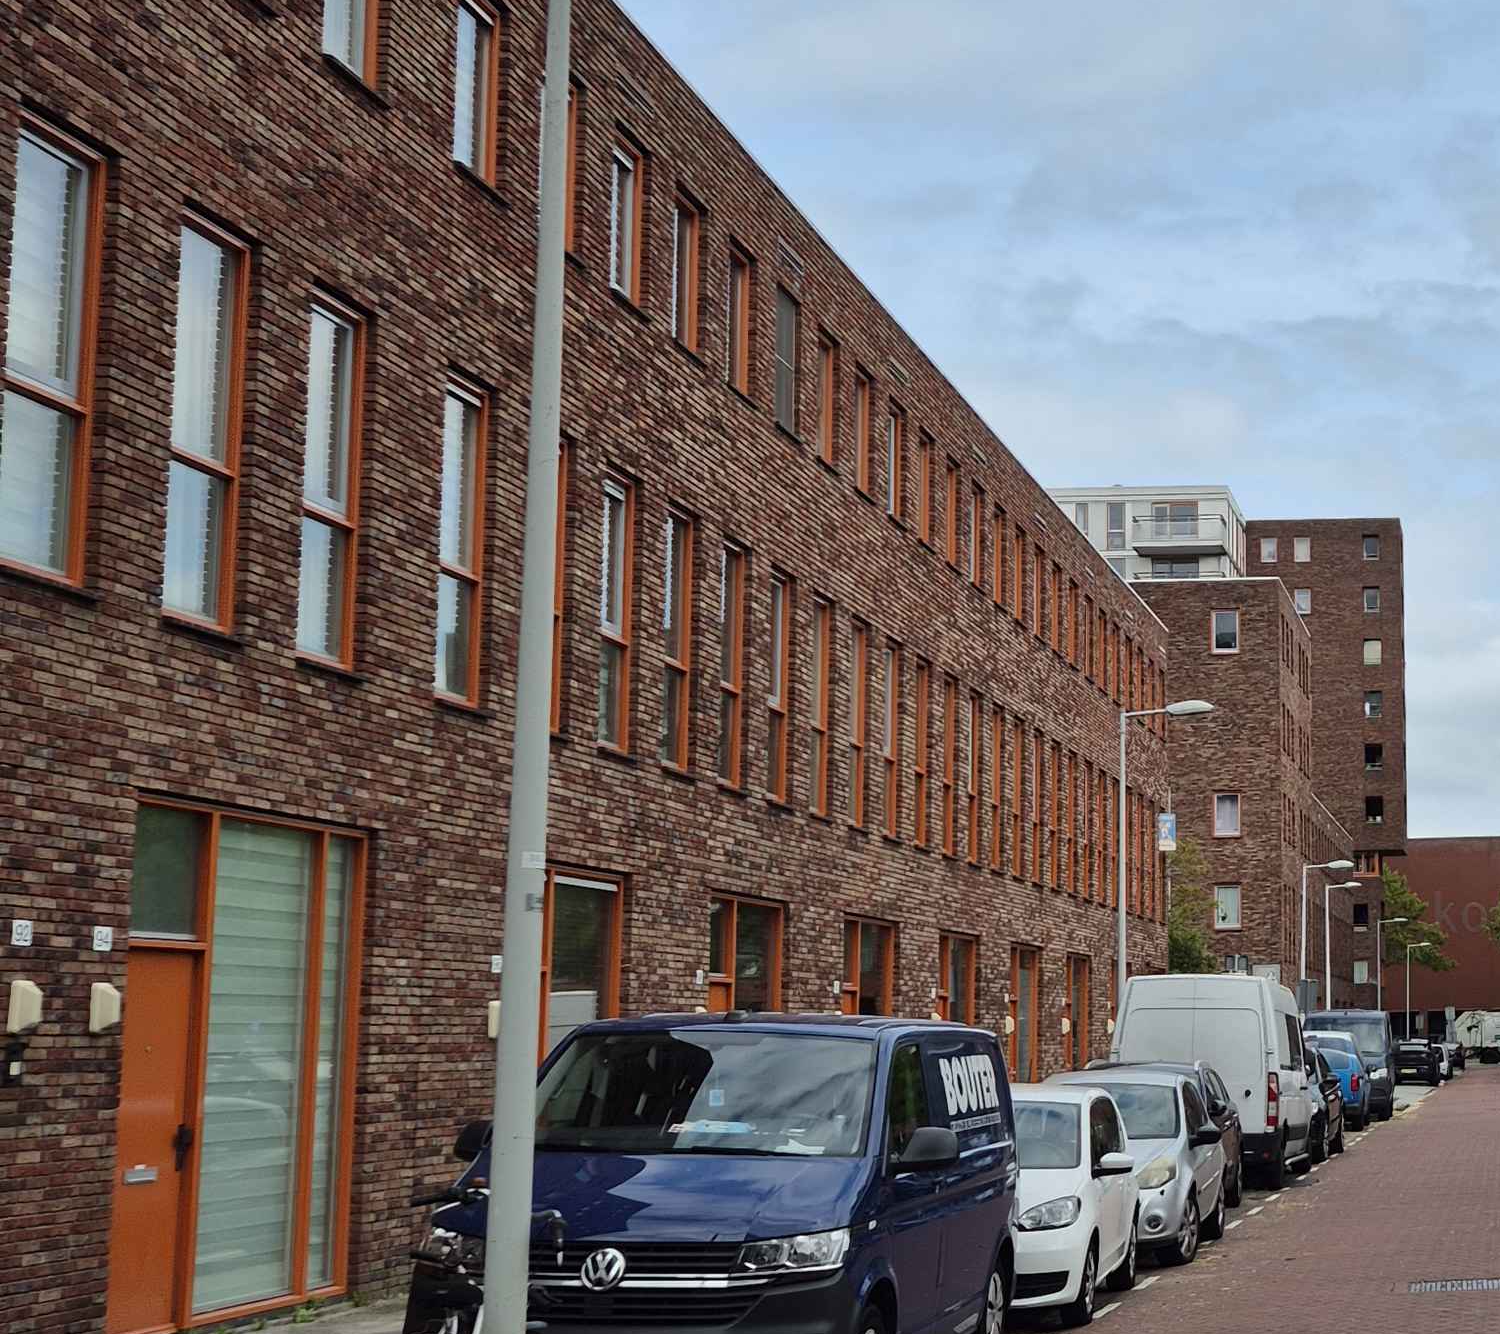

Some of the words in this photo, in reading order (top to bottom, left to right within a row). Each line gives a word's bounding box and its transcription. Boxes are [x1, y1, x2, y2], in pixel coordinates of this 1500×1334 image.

[14, 923, 30, 942] 92
[95, 930, 110, 947] 94
[938, 1054, 1000, 1116] BOUTER
